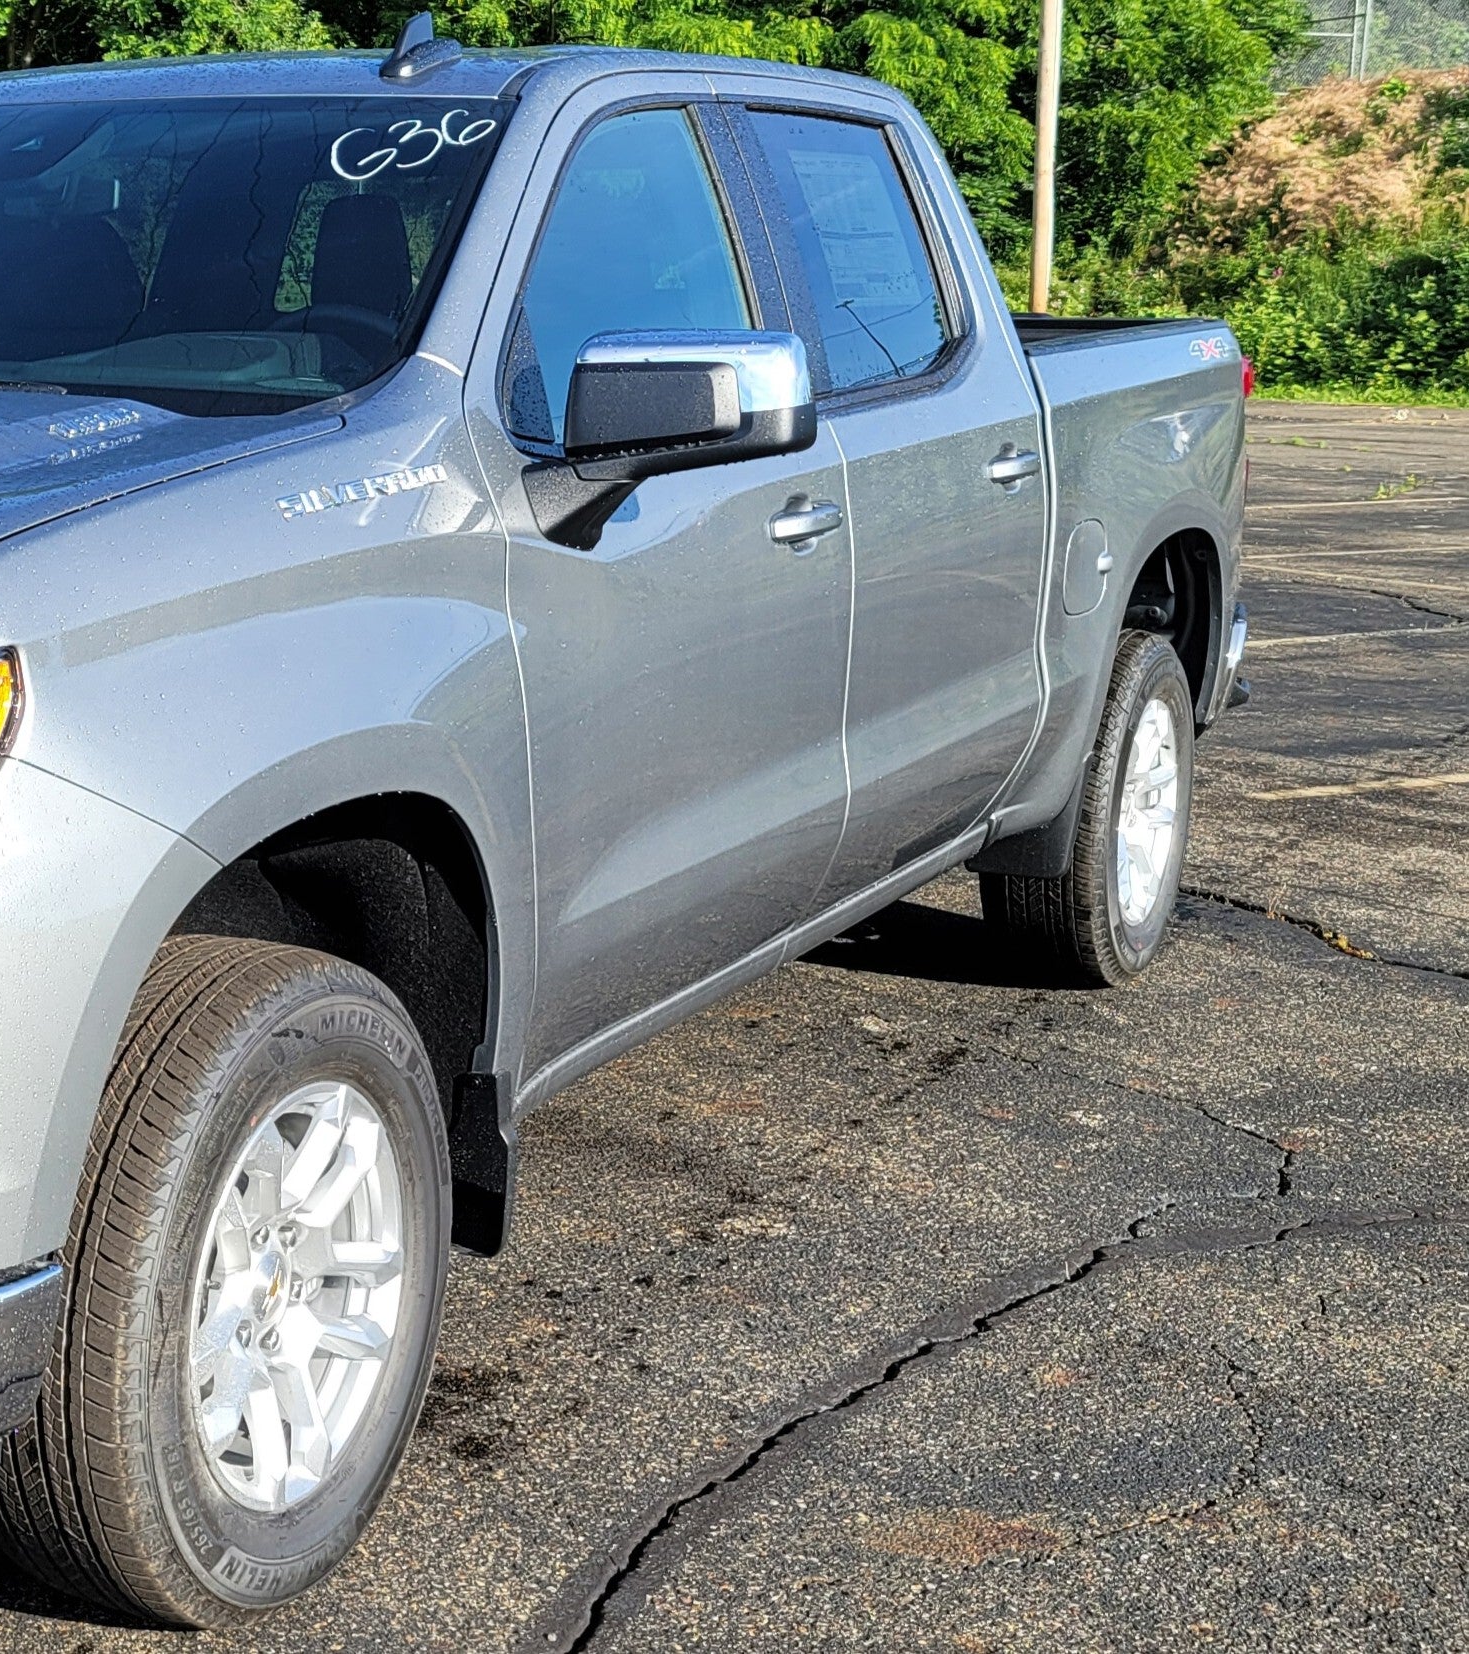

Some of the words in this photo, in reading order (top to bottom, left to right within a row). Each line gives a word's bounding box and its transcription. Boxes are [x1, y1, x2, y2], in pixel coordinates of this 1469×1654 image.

[275, 463, 448, 522] SILVERADO
[319, 1009, 409, 1056] MICHELIN
[177, 1497, 213, 1555] 265/65
